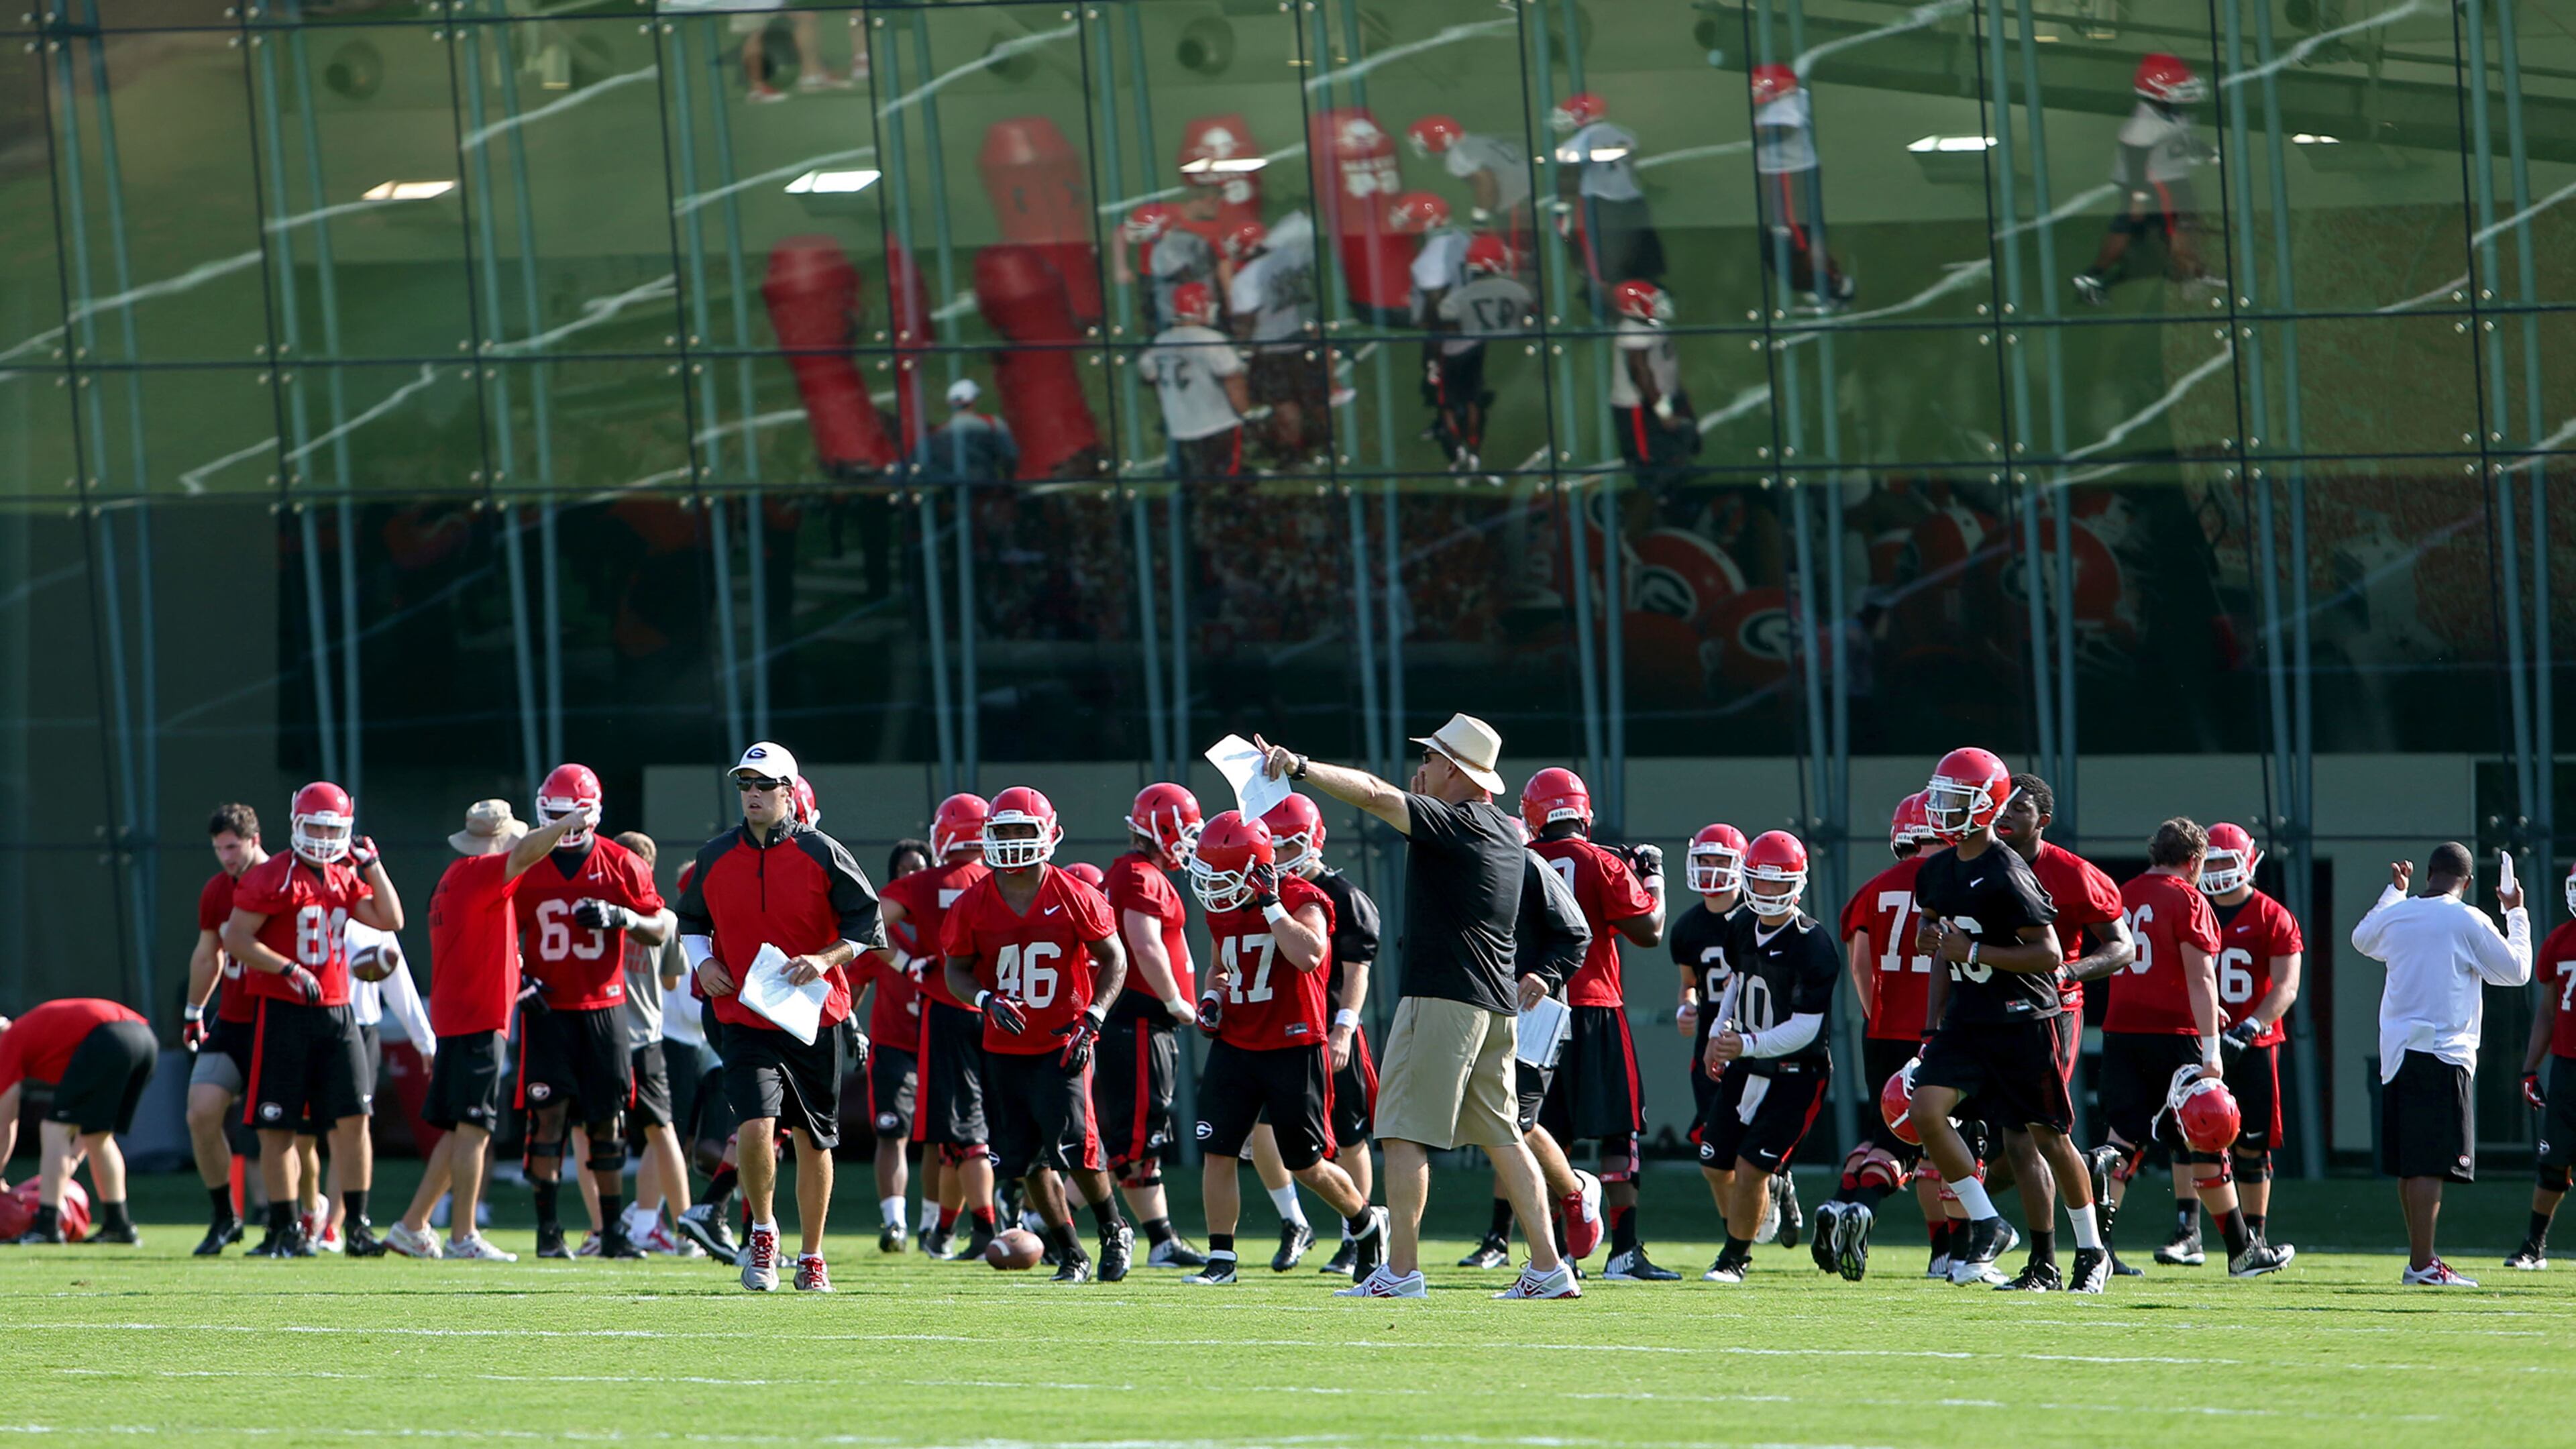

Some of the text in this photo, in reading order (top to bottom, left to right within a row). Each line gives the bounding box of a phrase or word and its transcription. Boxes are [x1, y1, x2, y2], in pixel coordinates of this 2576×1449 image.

[747, 747, 767, 759] G
[536, 898, 604, 961] 63
[996, 942, 1061, 1008] 46
[1221, 934, 1275, 1004] 47
[1733, 972, 1774, 1032] 10
[1607, 1250, 1634, 1273] NIKE
